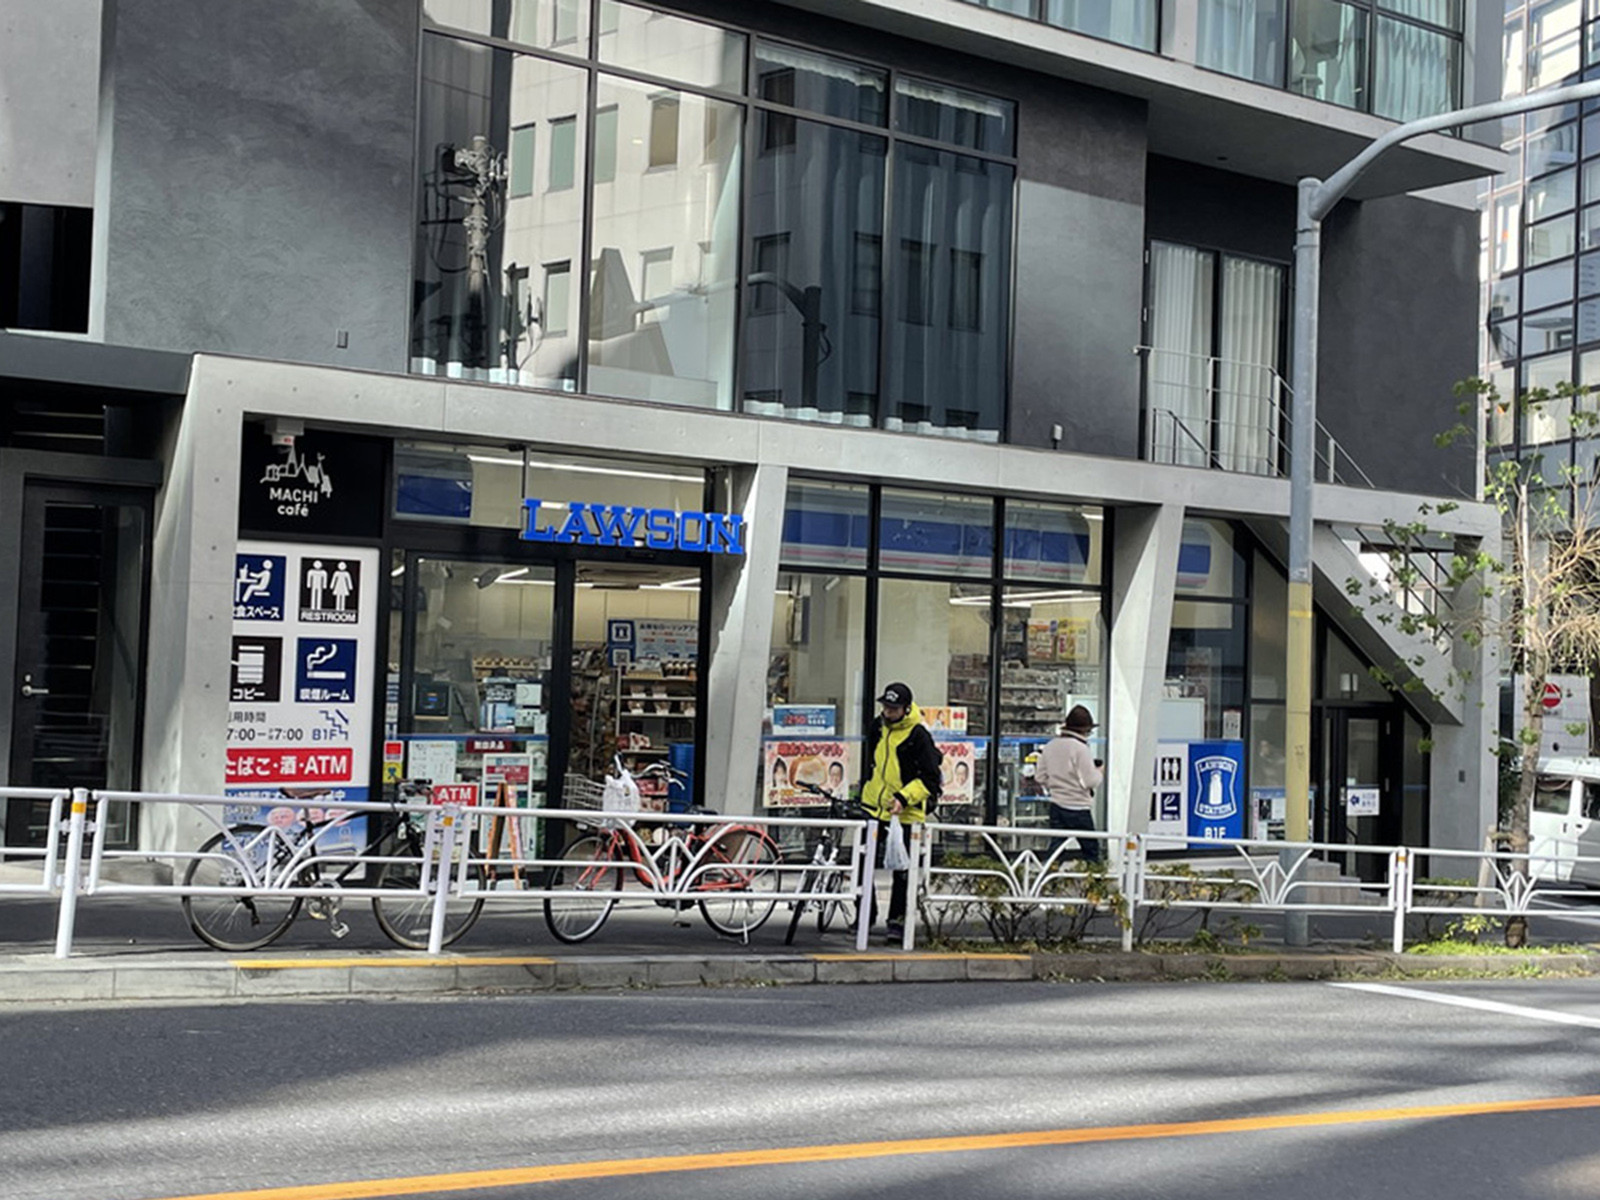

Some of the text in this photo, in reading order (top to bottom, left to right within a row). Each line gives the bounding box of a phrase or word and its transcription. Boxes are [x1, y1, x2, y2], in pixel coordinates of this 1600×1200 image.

[269, 487, 319, 503] MACHI
[277, 502, 310, 517] café
[520, 498, 745, 554] LAWSON
[232, 604, 280, 619] 食スペース
[300, 610, 357, 622] RESTROOM
[232, 687, 266, 700] コピー
[312, 728, 337, 741] B1F
[438, 786, 472, 801] ATM
[1204, 826, 1227, 840] B1F
